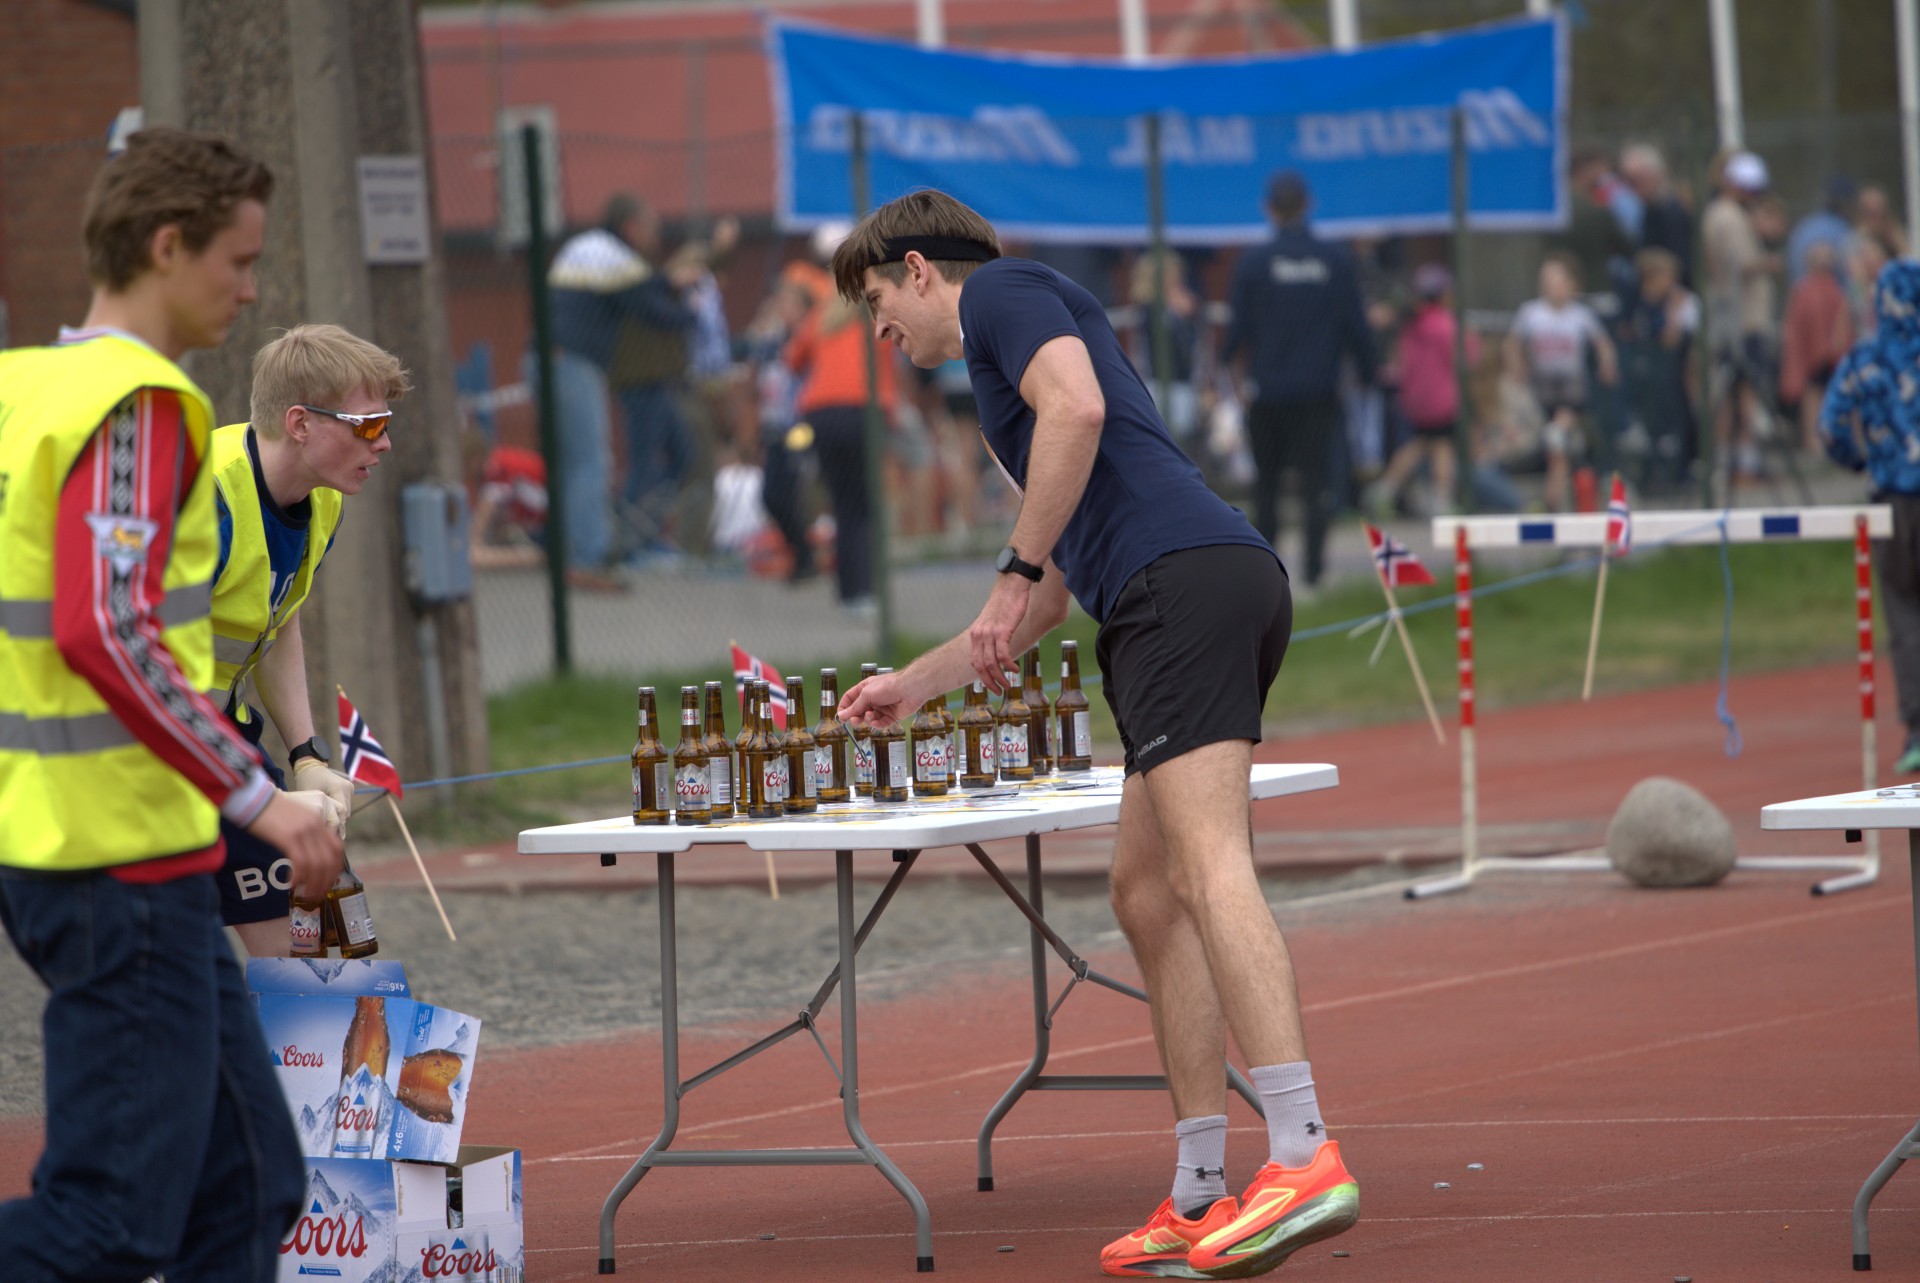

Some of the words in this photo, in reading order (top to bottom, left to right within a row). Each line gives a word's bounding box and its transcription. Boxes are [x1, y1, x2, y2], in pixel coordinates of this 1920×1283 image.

[1137, 735, 1167, 759] HEAD
[675, 779, 710, 796] Coors
[290, 920, 319, 938] oors
[283, 1045, 324, 1068] Coors
[393, 1131, 404, 1152] 4x6
[420, 1243, 498, 1279] Coors
